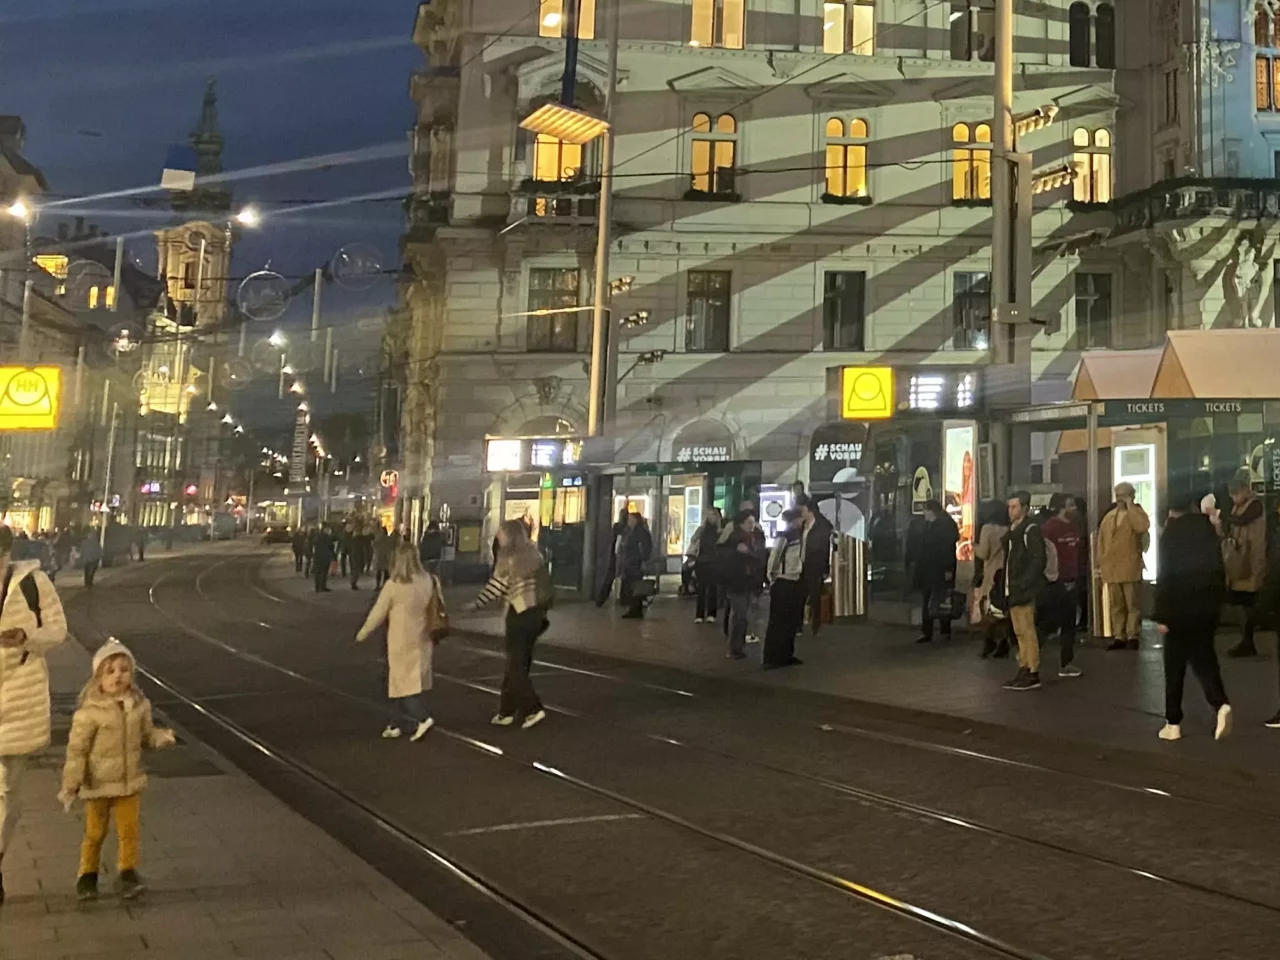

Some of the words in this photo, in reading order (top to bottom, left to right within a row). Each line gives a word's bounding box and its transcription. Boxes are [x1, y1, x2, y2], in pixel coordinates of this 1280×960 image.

[1127, 403, 1165, 413] TICKETS
[1205, 402, 1242, 412] TICKETS
[1273, 449, 1280, 490] TICKETS
